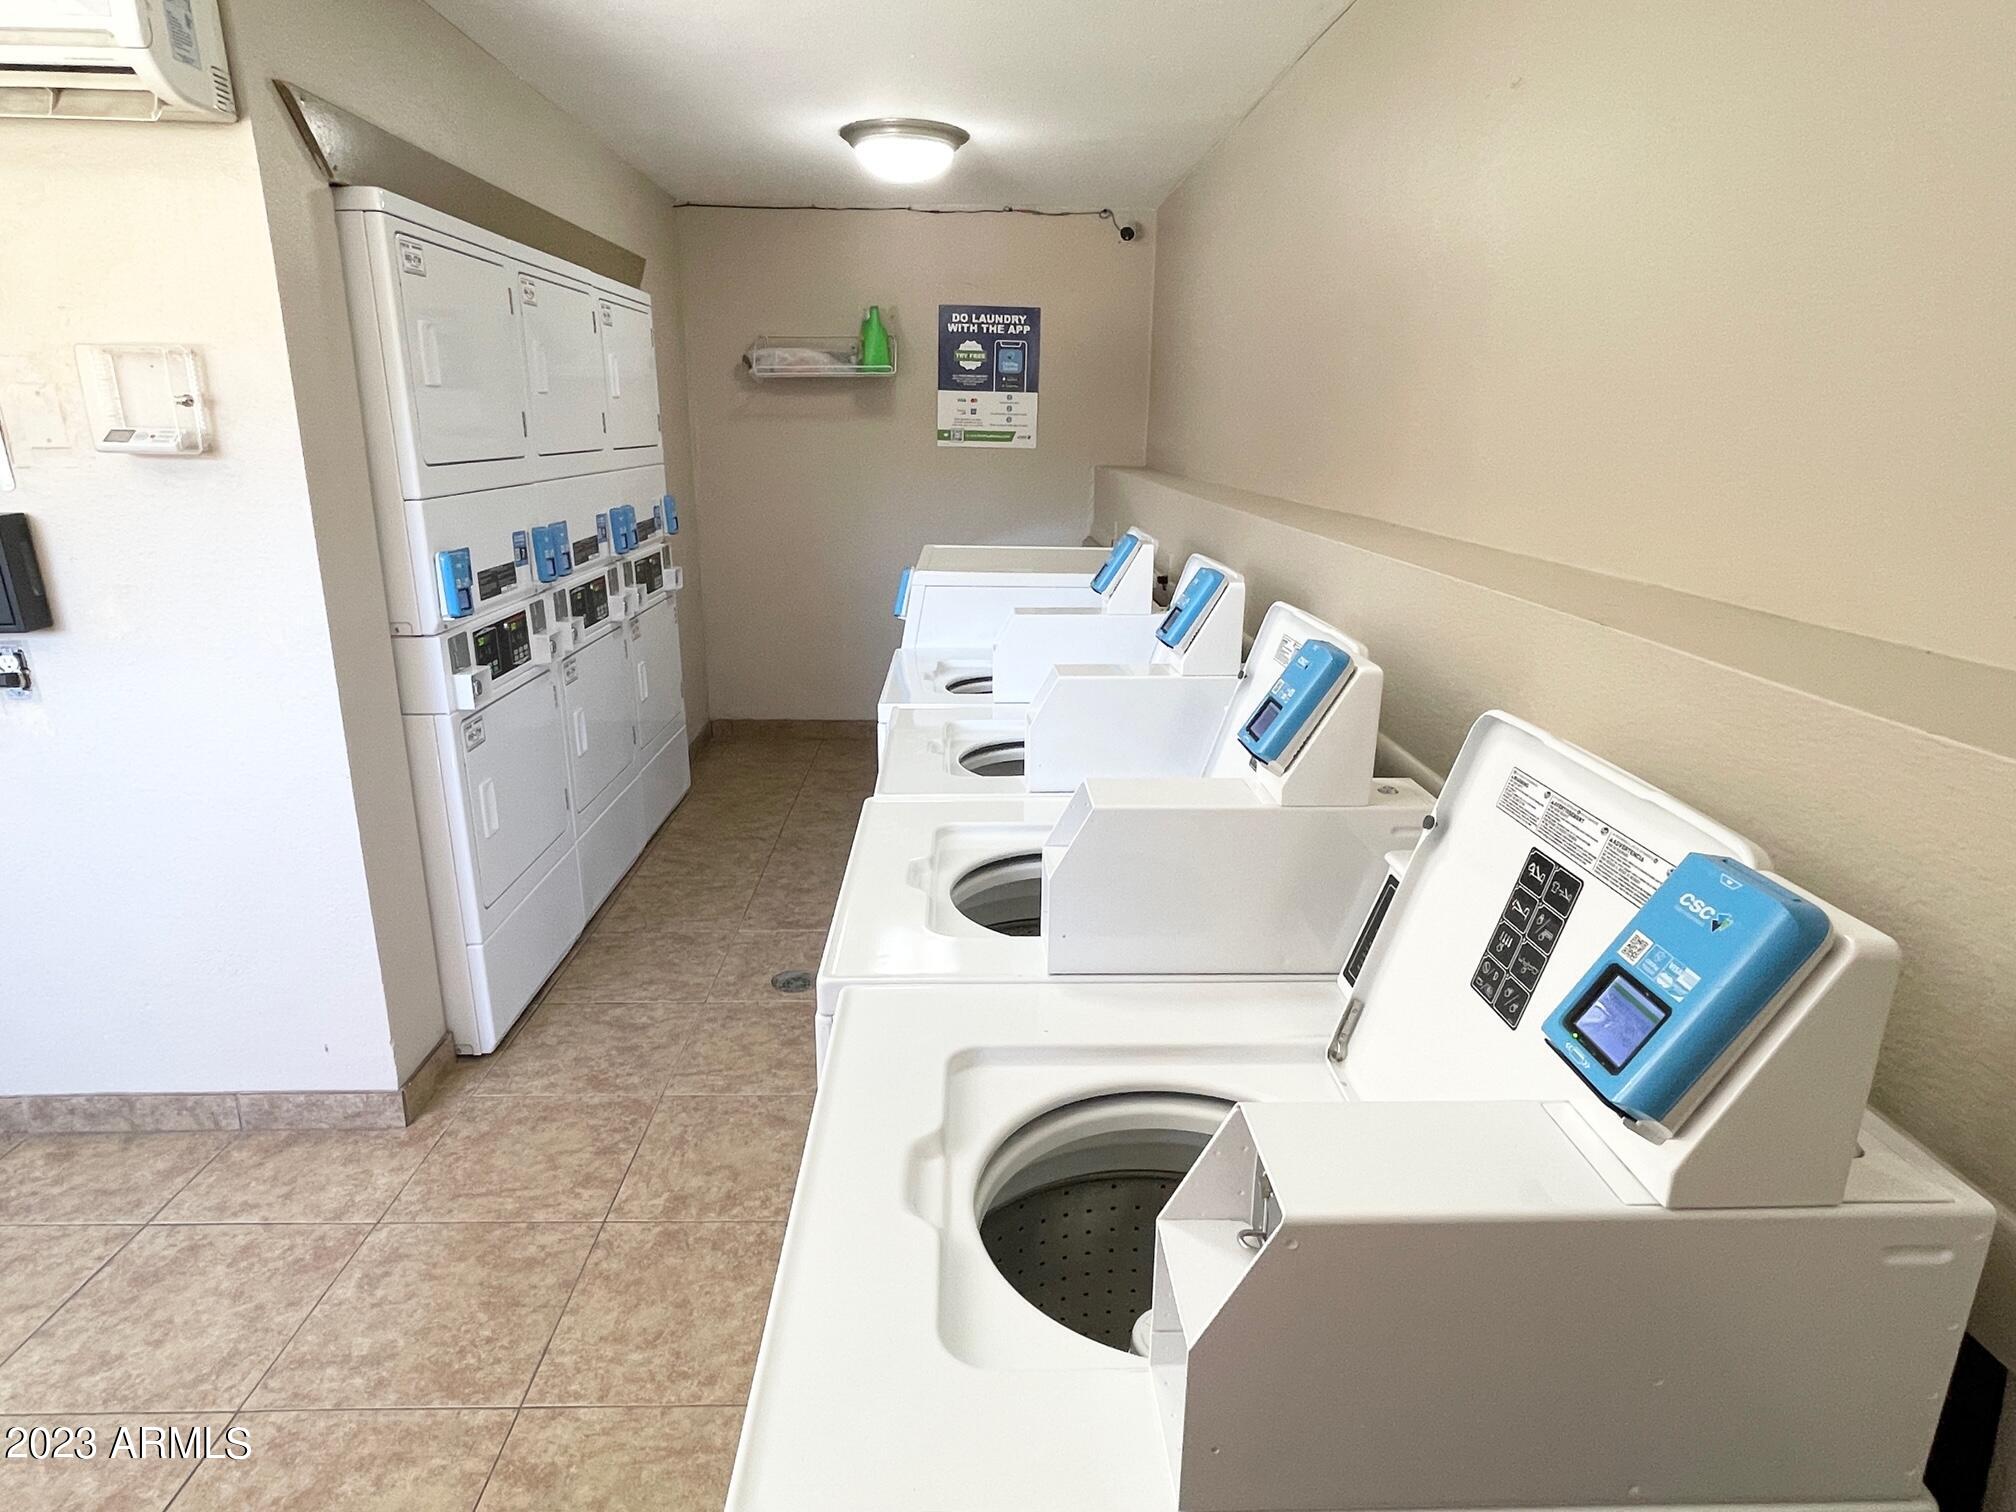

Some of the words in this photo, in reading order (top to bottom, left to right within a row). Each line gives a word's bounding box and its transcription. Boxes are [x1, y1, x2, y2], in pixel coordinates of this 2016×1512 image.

[952, 313, 968, 322] DO
[972, 314, 1027, 324] LAUNDRY
[947, 323, 978, 333] WITH
[981, 324, 1005, 334] THE
[1007, 325, 1031, 334] APP
[1679, 893, 1716, 920] CSC
